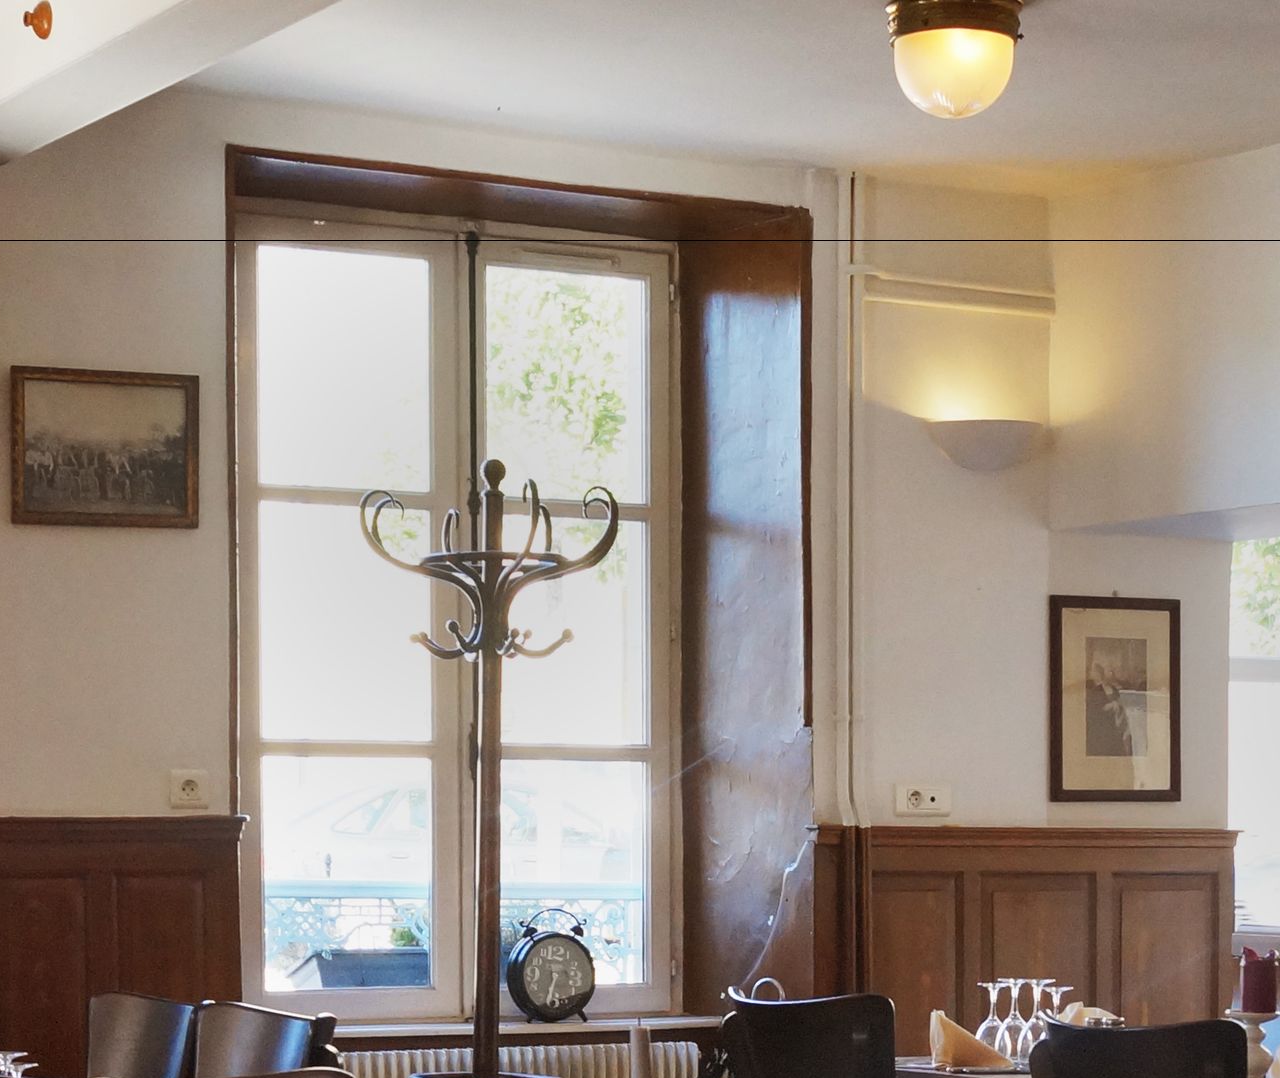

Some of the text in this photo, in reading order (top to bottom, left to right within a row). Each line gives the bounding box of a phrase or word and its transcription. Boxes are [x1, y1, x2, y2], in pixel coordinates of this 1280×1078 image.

[547, 945, 565, 961] 12
[526, 966, 540, 982] 9
[569, 970, 582, 987] 3
